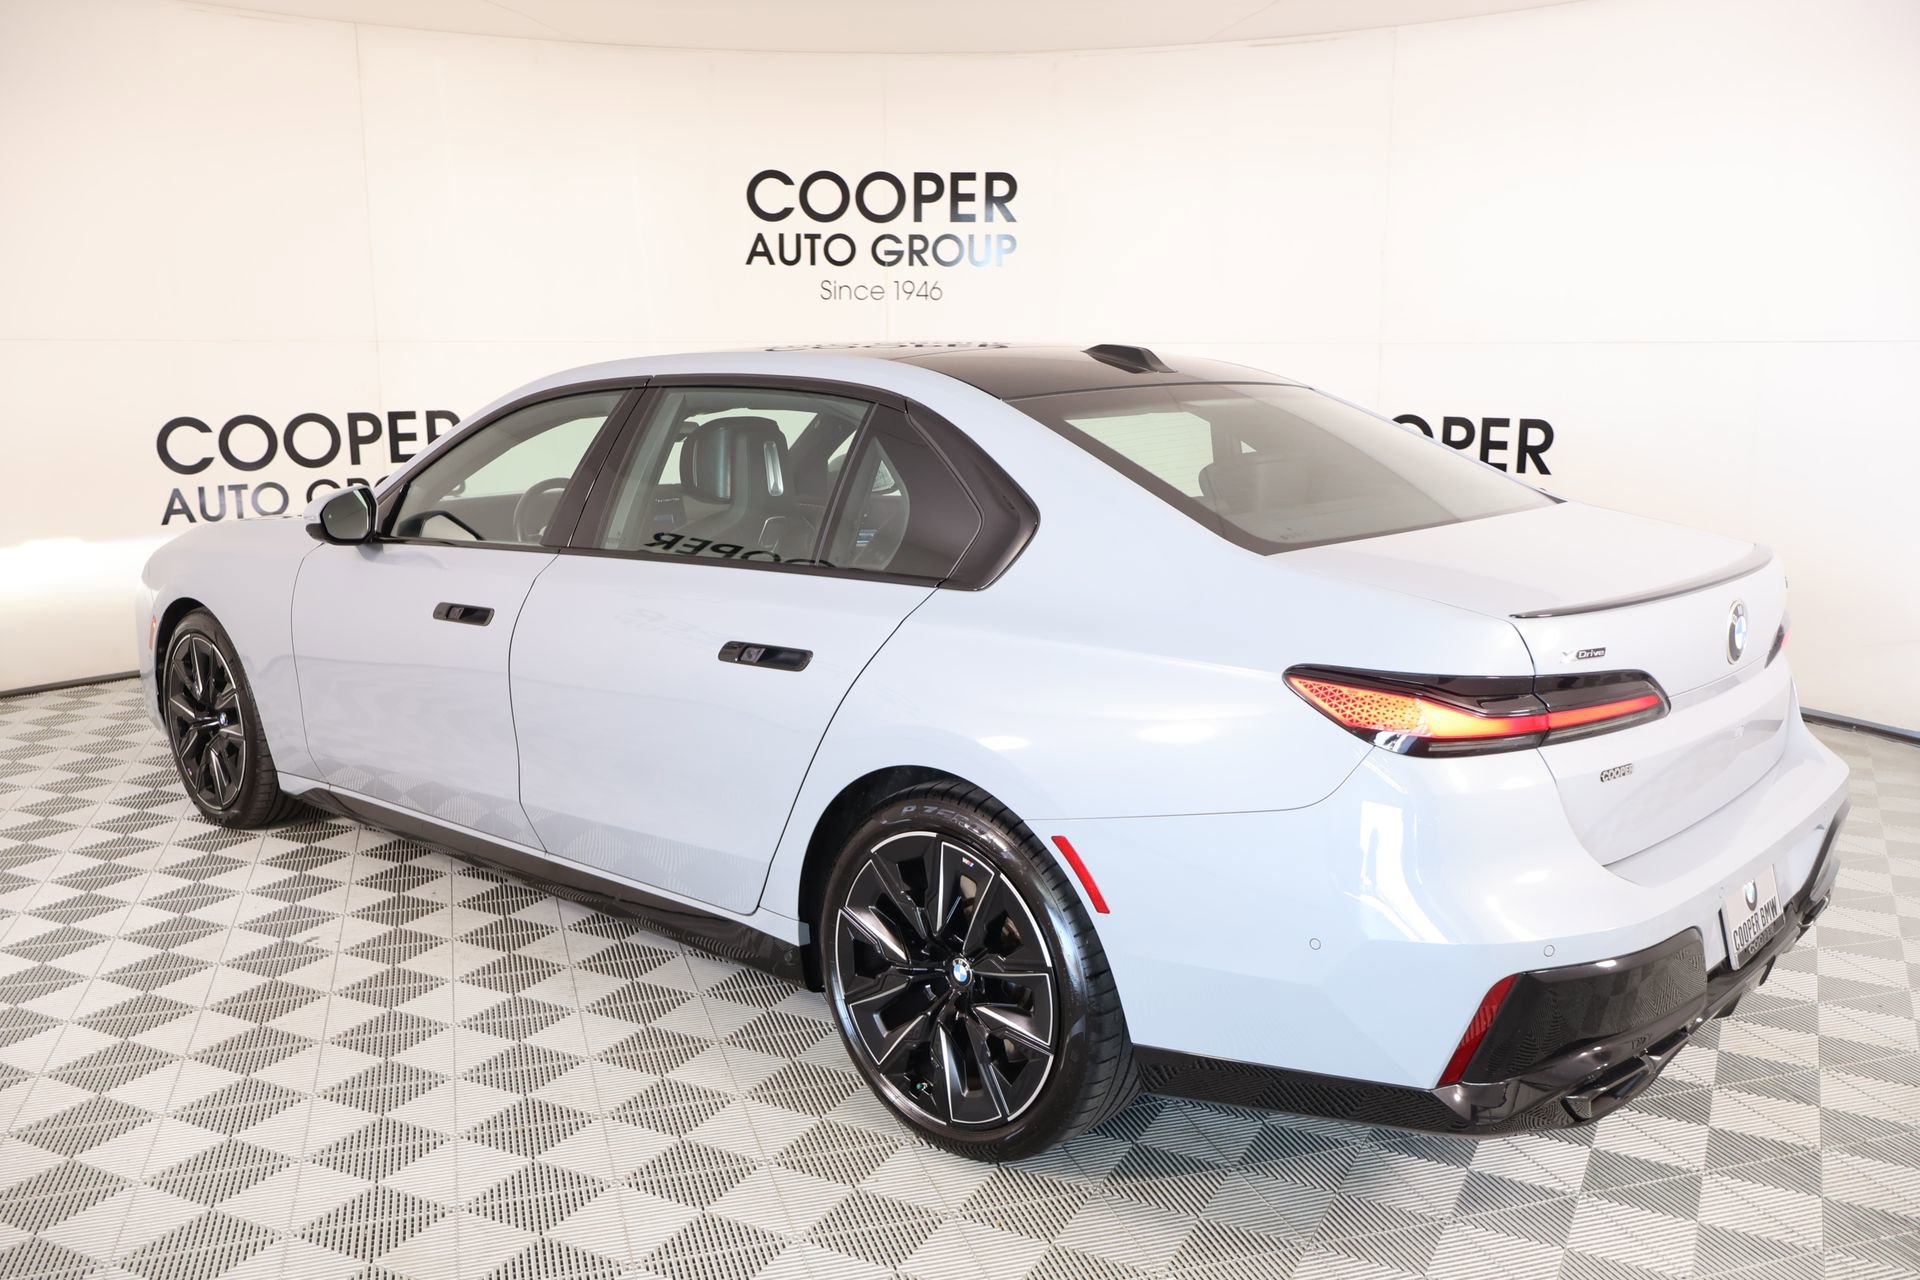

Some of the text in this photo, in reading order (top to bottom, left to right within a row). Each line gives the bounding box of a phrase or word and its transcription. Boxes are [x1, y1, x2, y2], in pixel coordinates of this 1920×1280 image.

[746, 169, 1018, 223] COOPER
[745, 233, 1018, 267] AUTO GROUP
[820, 279, 943, 301] Since 1946
[161, 481, 289, 526] AUTO
[1600, 763, 1632, 782] COOPER
[1733, 896, 1778, 951] COOPER BMW
